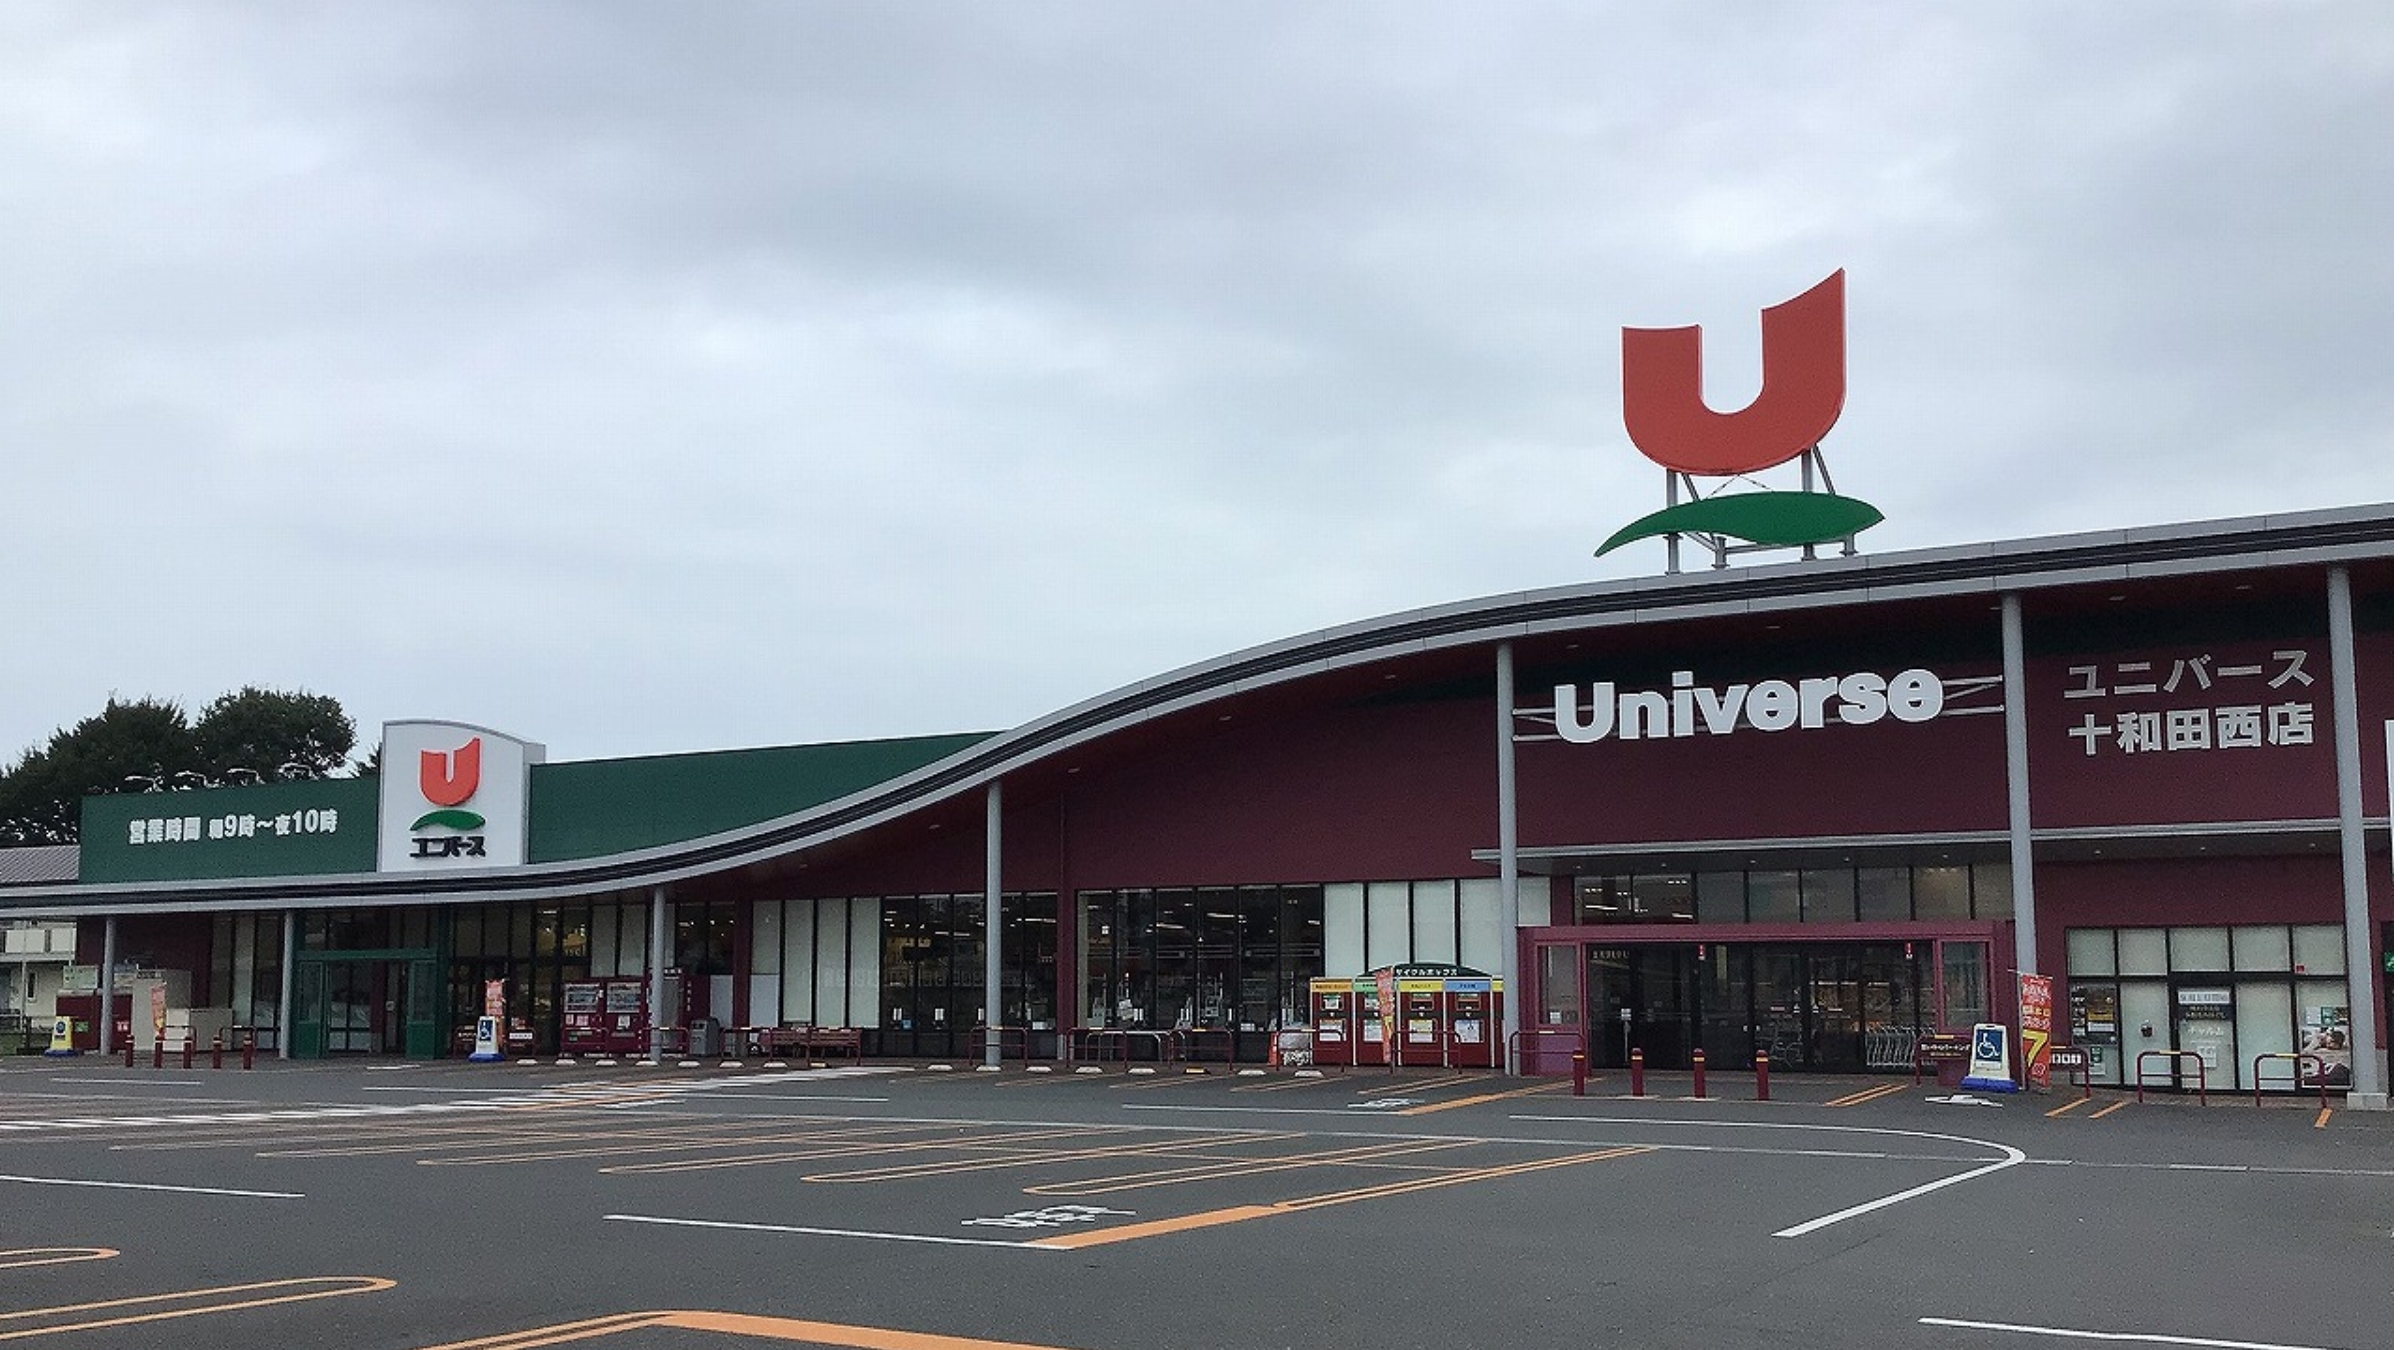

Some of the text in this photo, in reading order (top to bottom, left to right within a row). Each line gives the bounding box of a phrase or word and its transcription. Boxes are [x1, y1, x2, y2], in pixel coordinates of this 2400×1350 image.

[1621, 267, 1846, 476] U
[2064, 650, 2315, 698] ユニバース
[1554, 669, 1944, 743] Universe
[2068, 701, 2315, 756] 十和田西店
[129, 817, 201, 844] 営業時間
